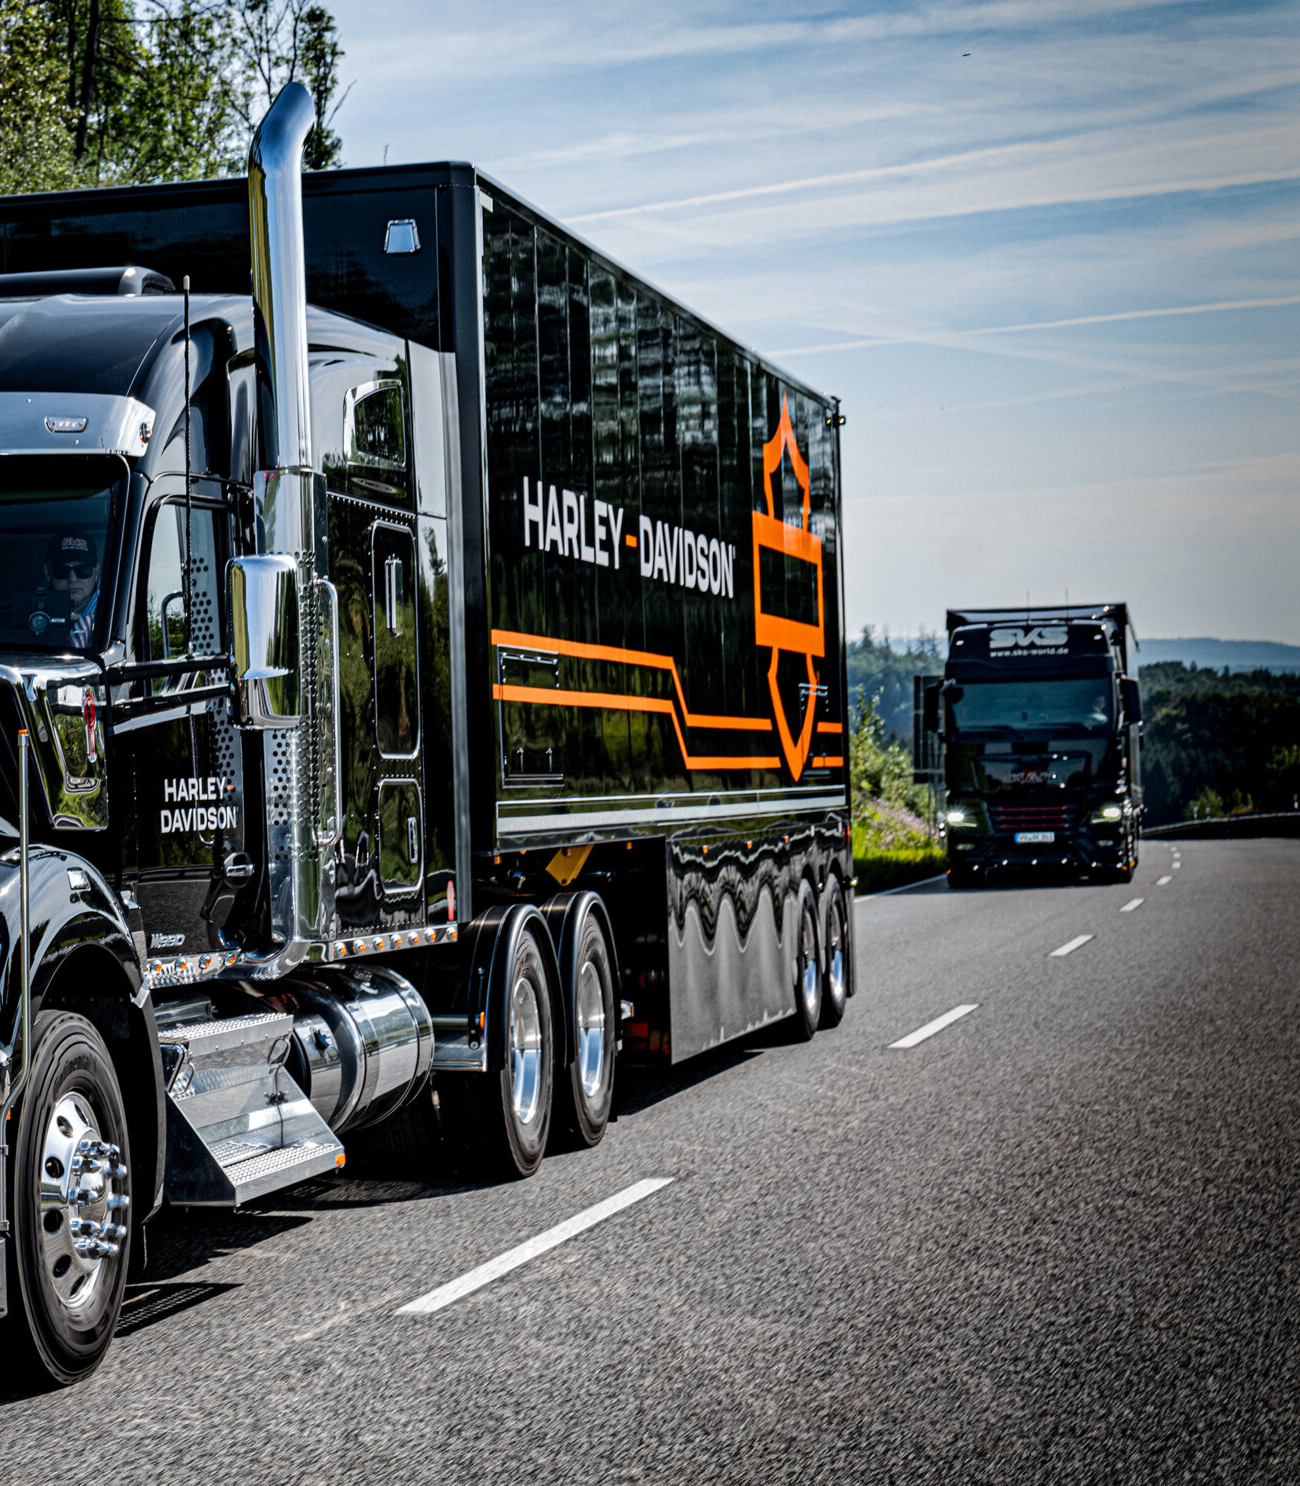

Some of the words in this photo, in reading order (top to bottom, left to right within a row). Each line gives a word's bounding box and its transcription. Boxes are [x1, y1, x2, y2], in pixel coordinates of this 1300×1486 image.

[523, 475, 735, 599] HARLEY-DAVIDSON
[989, 627, 1069, 649] SKS
[160, 805, 237, 834] DAVIDSON
